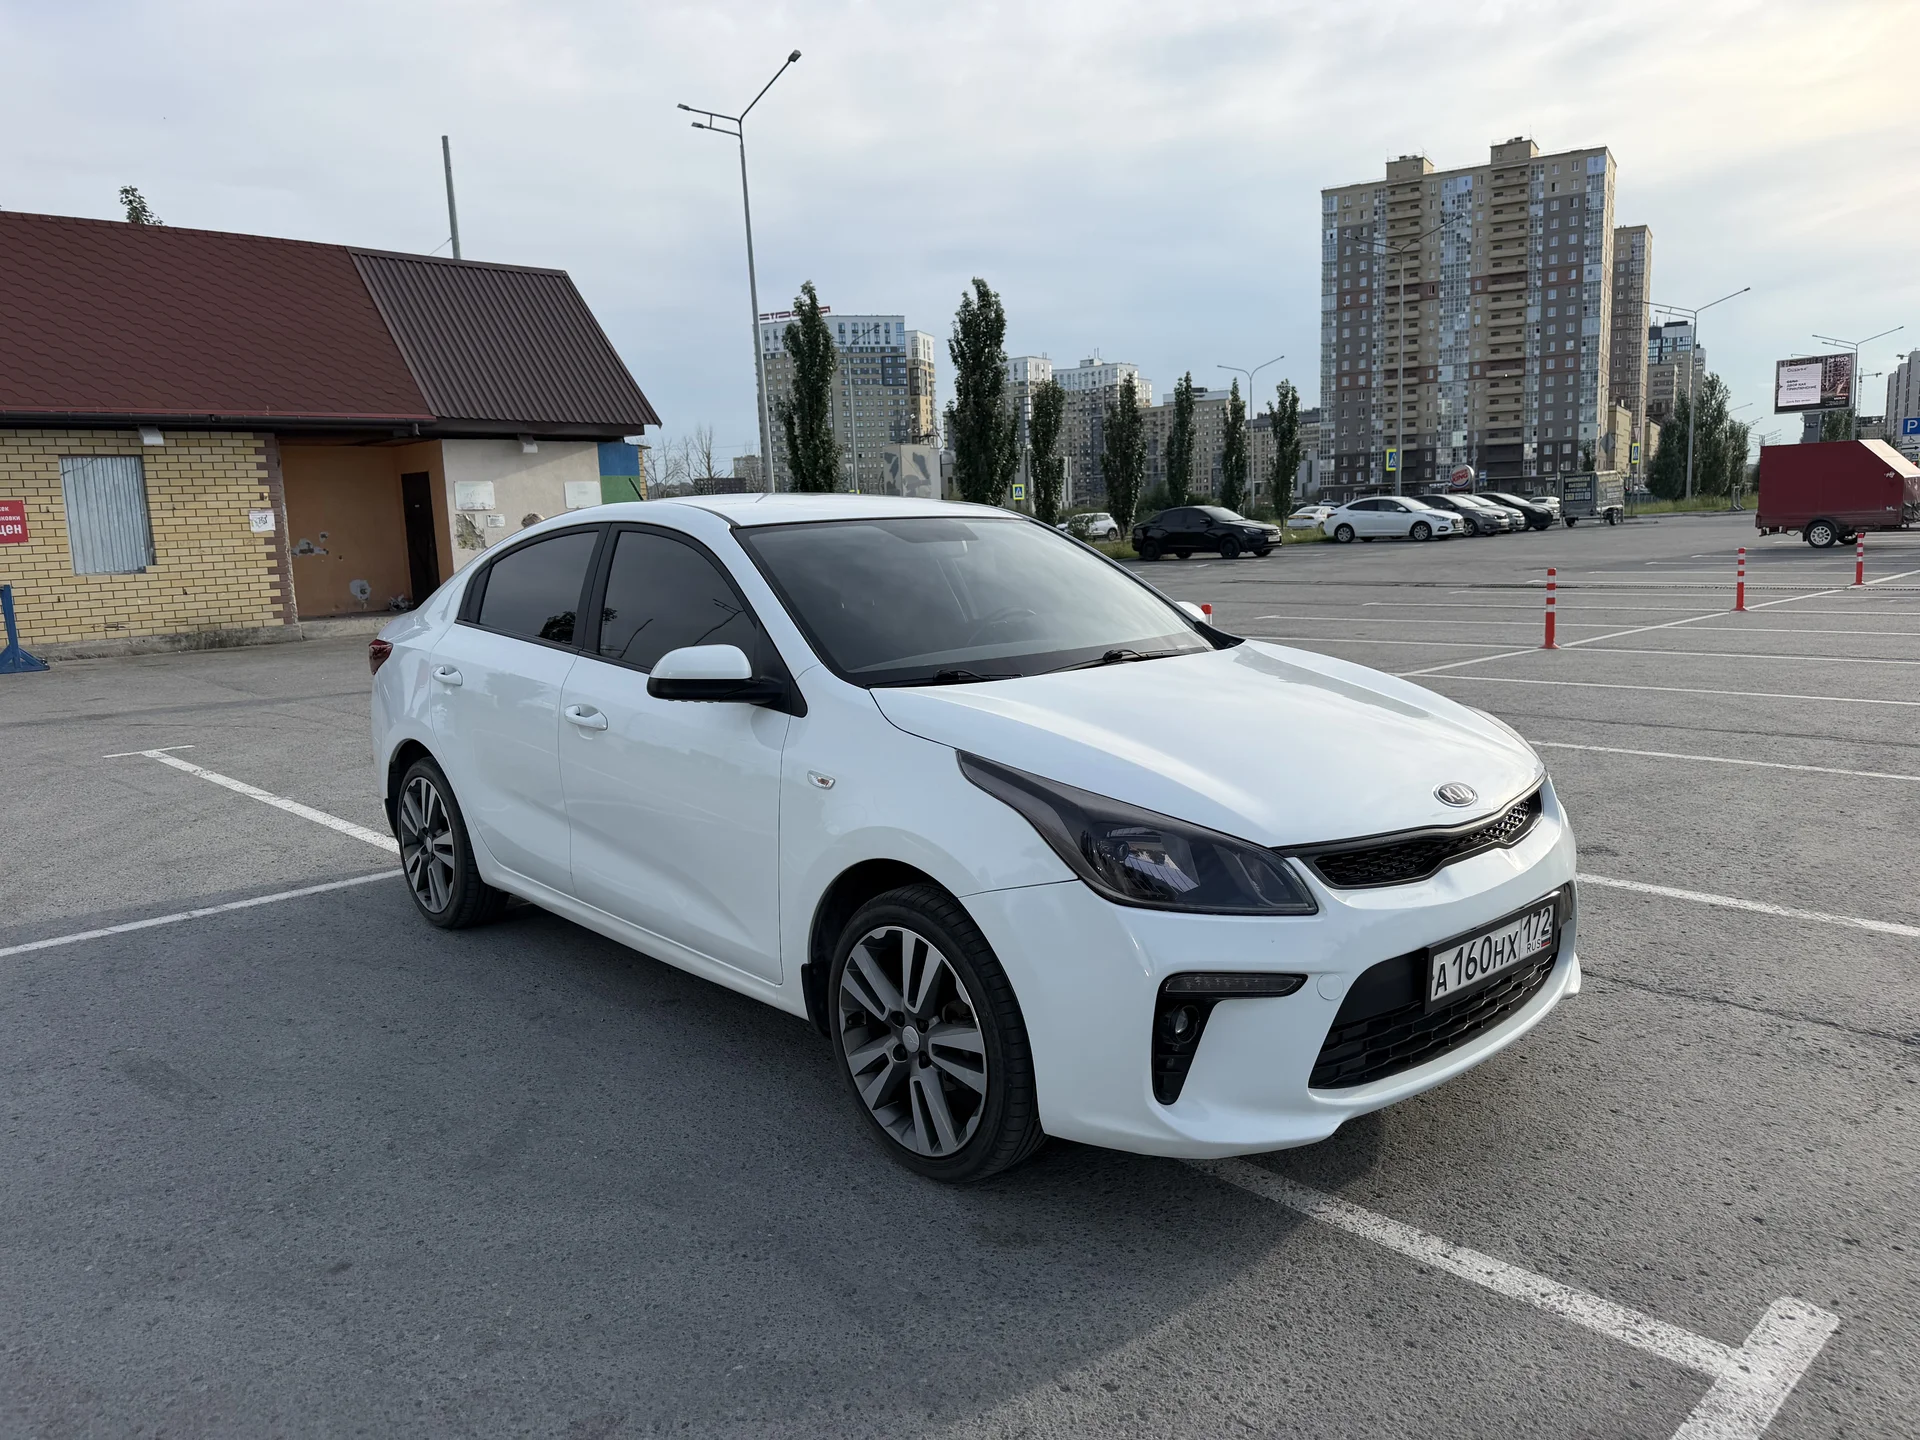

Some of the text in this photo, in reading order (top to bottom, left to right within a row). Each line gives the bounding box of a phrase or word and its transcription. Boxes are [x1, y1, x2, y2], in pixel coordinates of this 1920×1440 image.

[1907, 419, 1918, 433] P
[1523, 907, 1551, 943] 172
[1526, 938, 1541, 953] RUS
